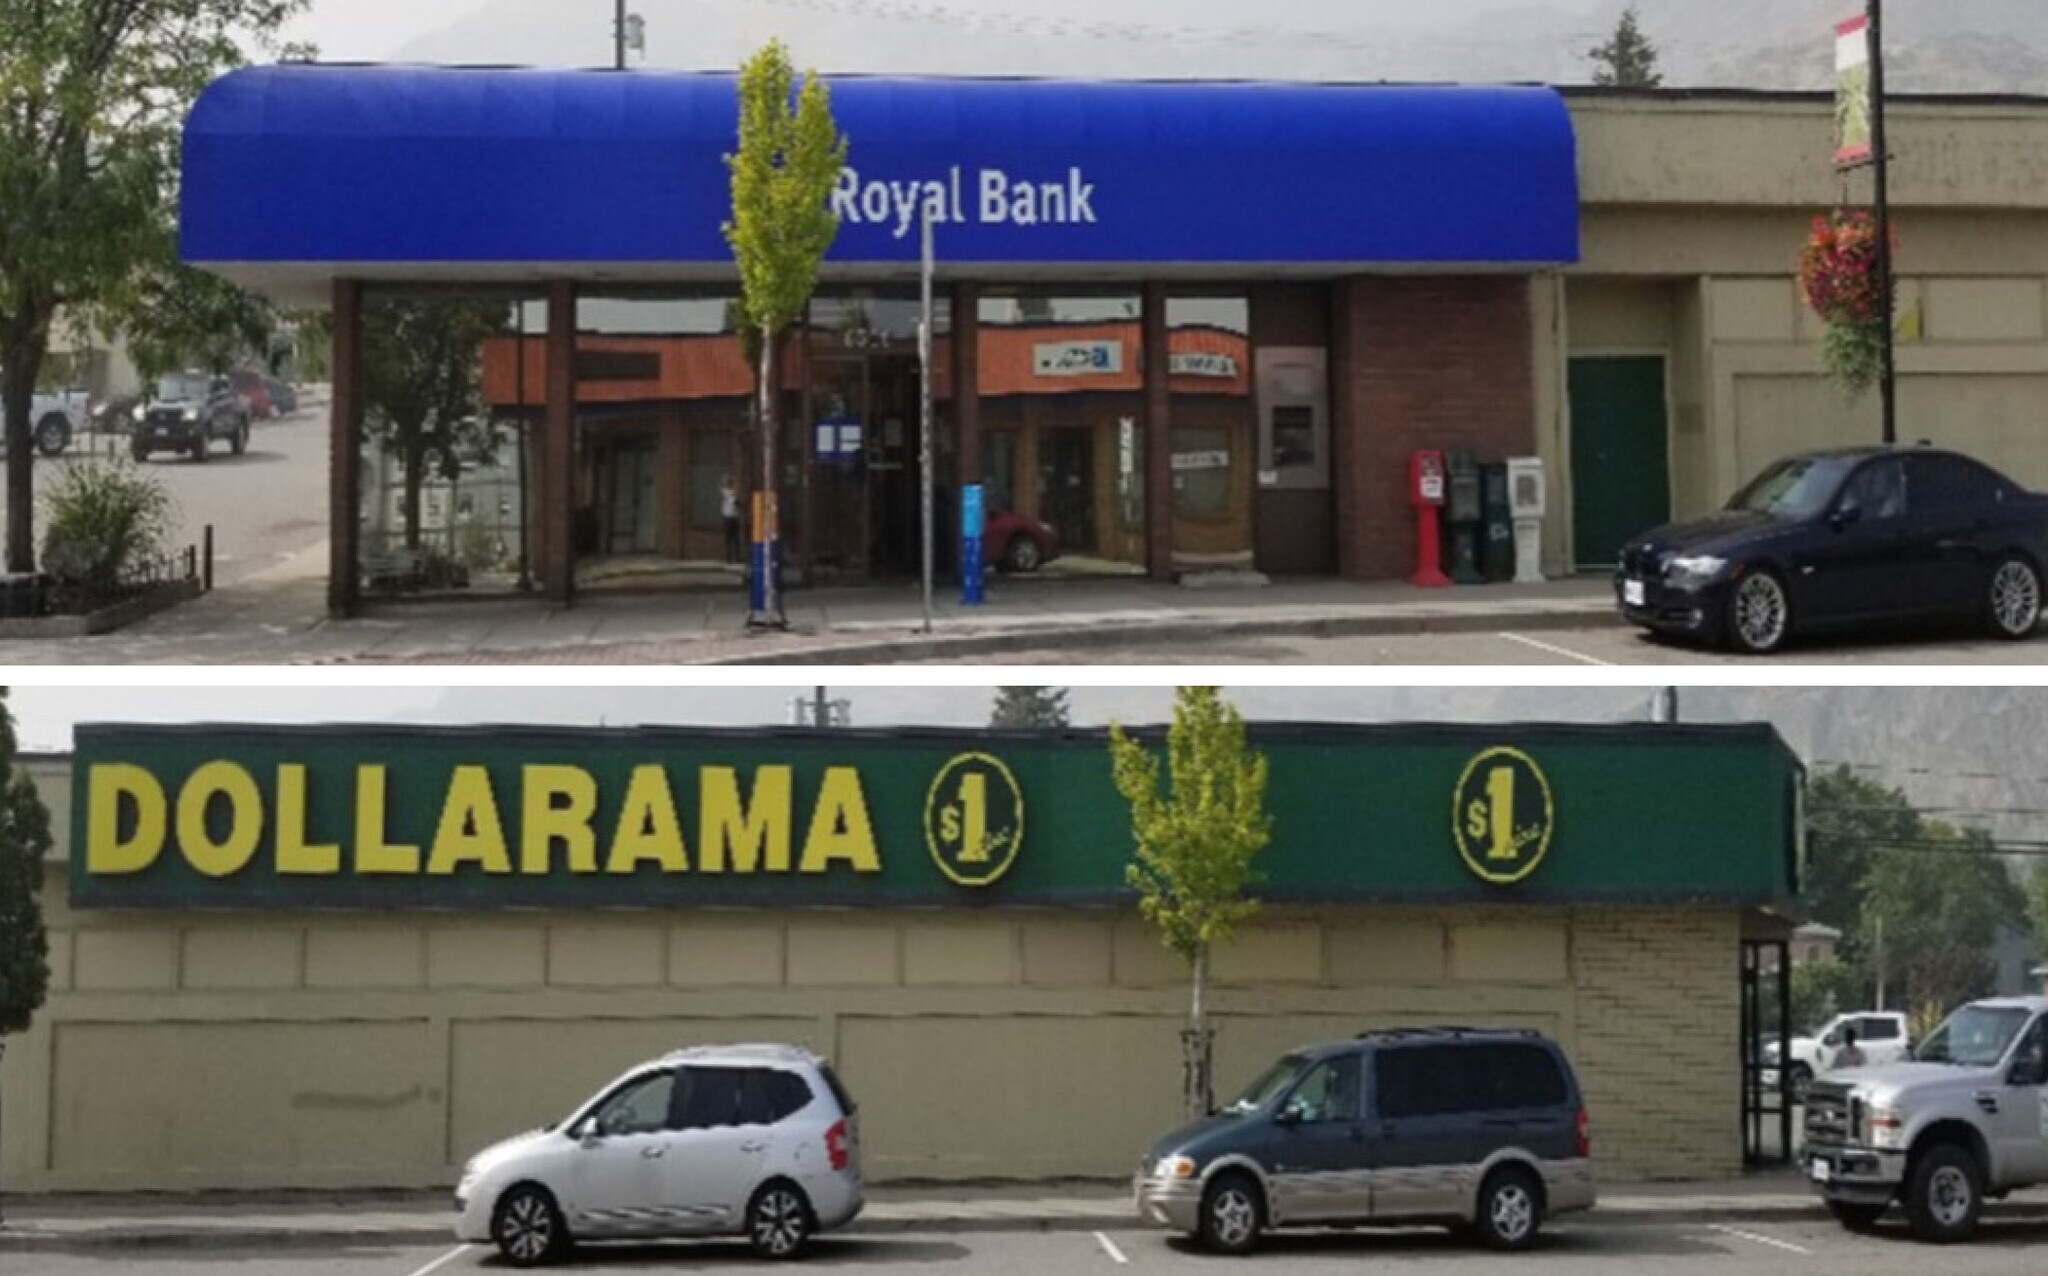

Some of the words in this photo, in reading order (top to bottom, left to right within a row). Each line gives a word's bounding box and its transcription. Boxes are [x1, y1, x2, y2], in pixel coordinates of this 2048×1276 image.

[832, 166, 964, 238] Royal
[979, 168, 1096, 223] Bank
[86, 760, 882, 876] DOLLARAMA
